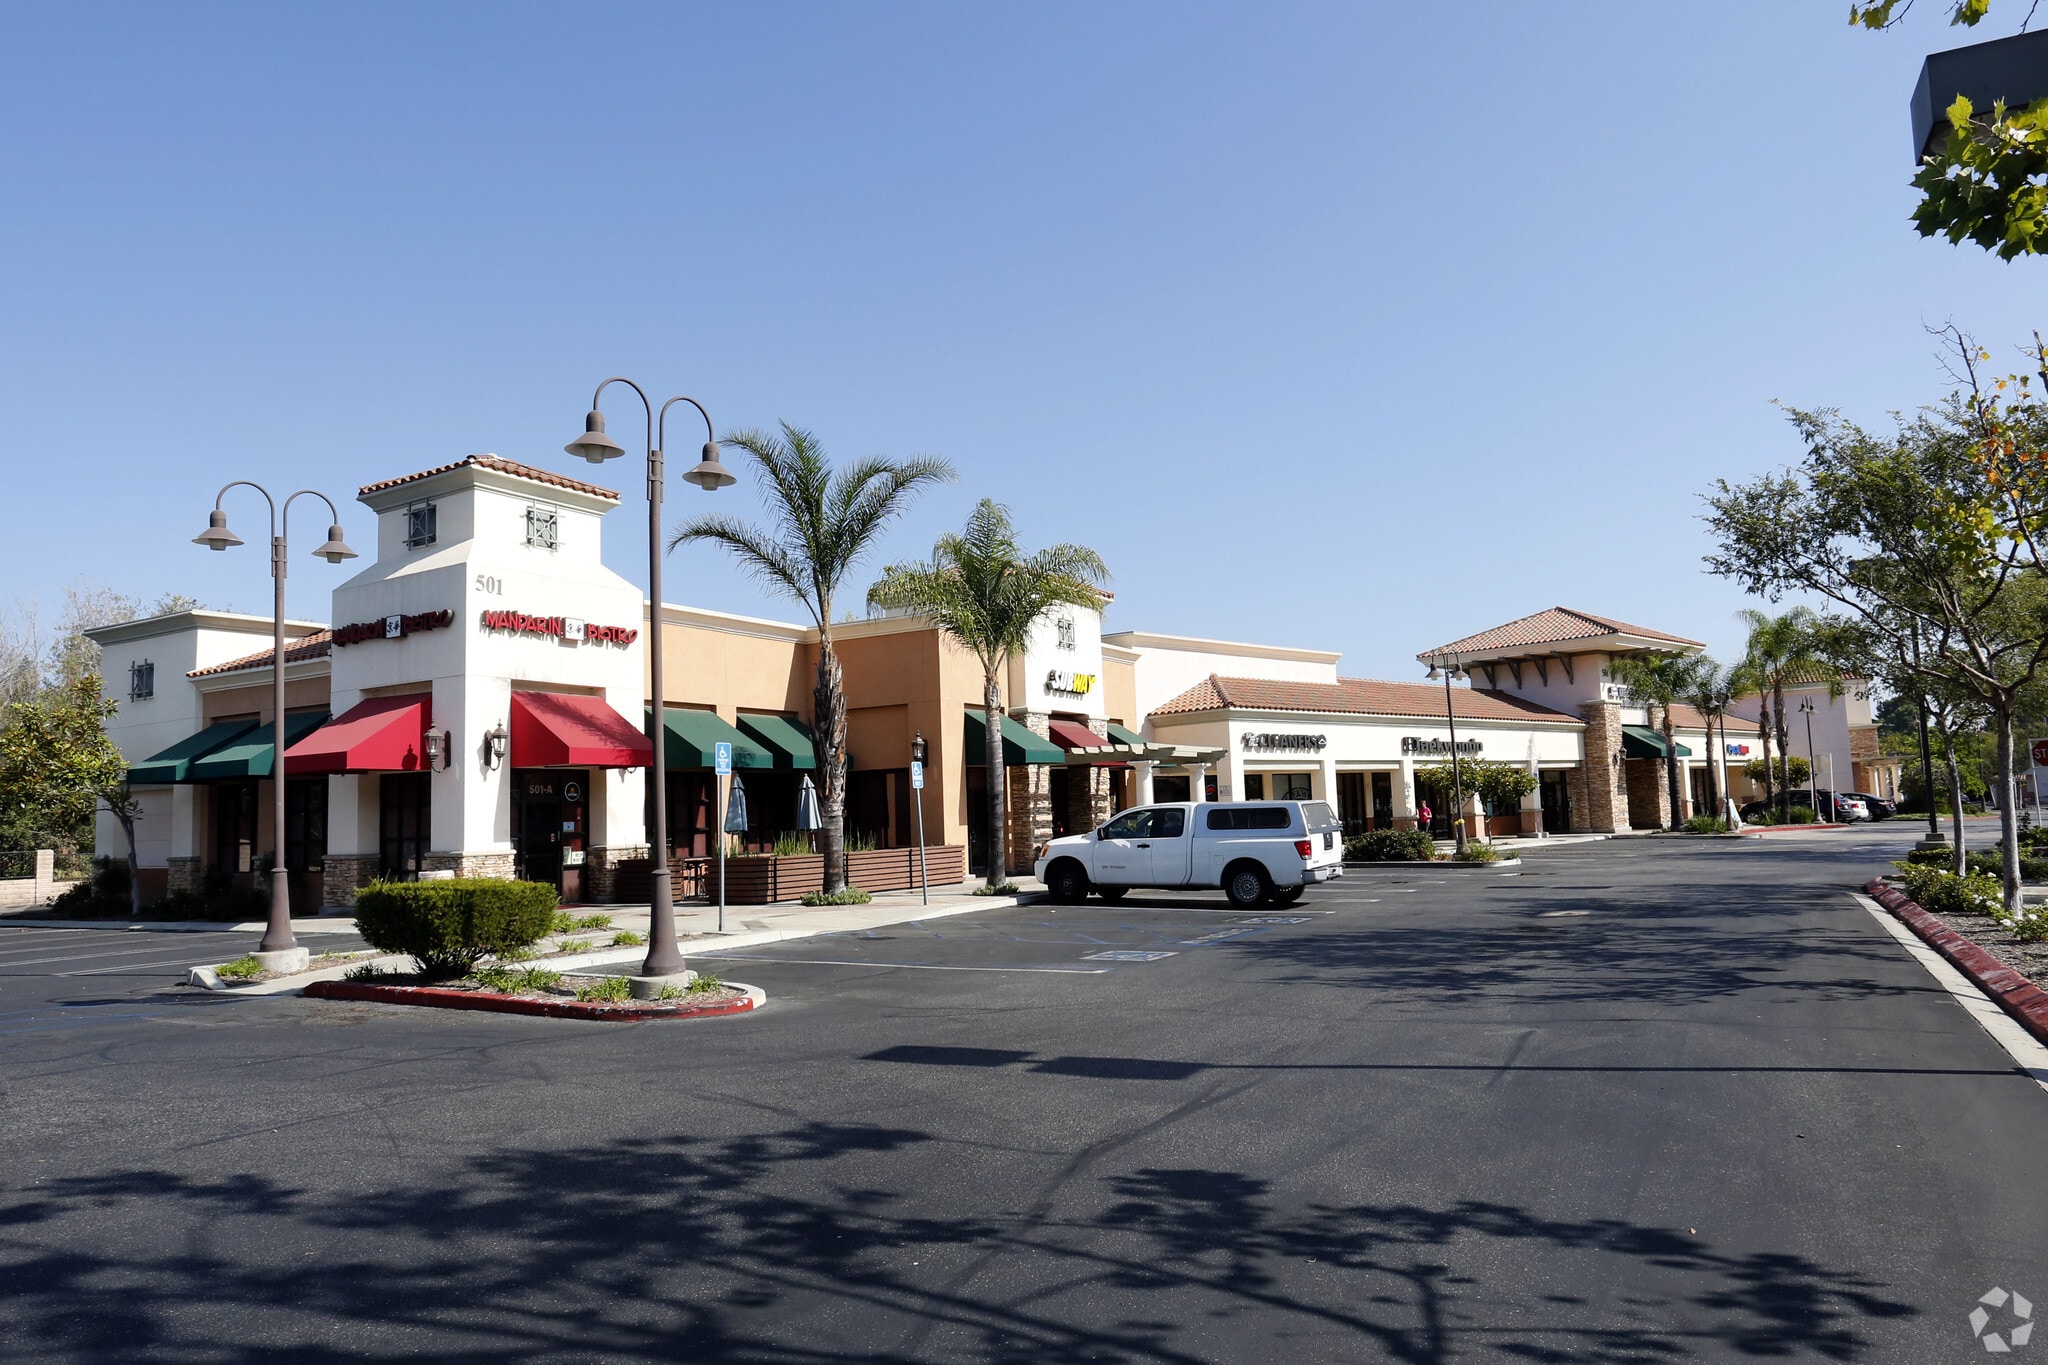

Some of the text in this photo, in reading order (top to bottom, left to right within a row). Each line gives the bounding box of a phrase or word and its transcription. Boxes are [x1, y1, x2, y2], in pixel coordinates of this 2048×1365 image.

[475, 574, 503, 595] 501
[483, 610, 562, 637] MANDARIN
[587, 623, 639, 645] BISTRO
[1048, 669, 1097, 694] SUBWAY
[1259, 733, 1317, 749] CLEANERS
[1414, 737, 1483, 753] Taekwondo
[2034, 748, 2048, 759] ST
[529, 785, 553, 794] 501-A
